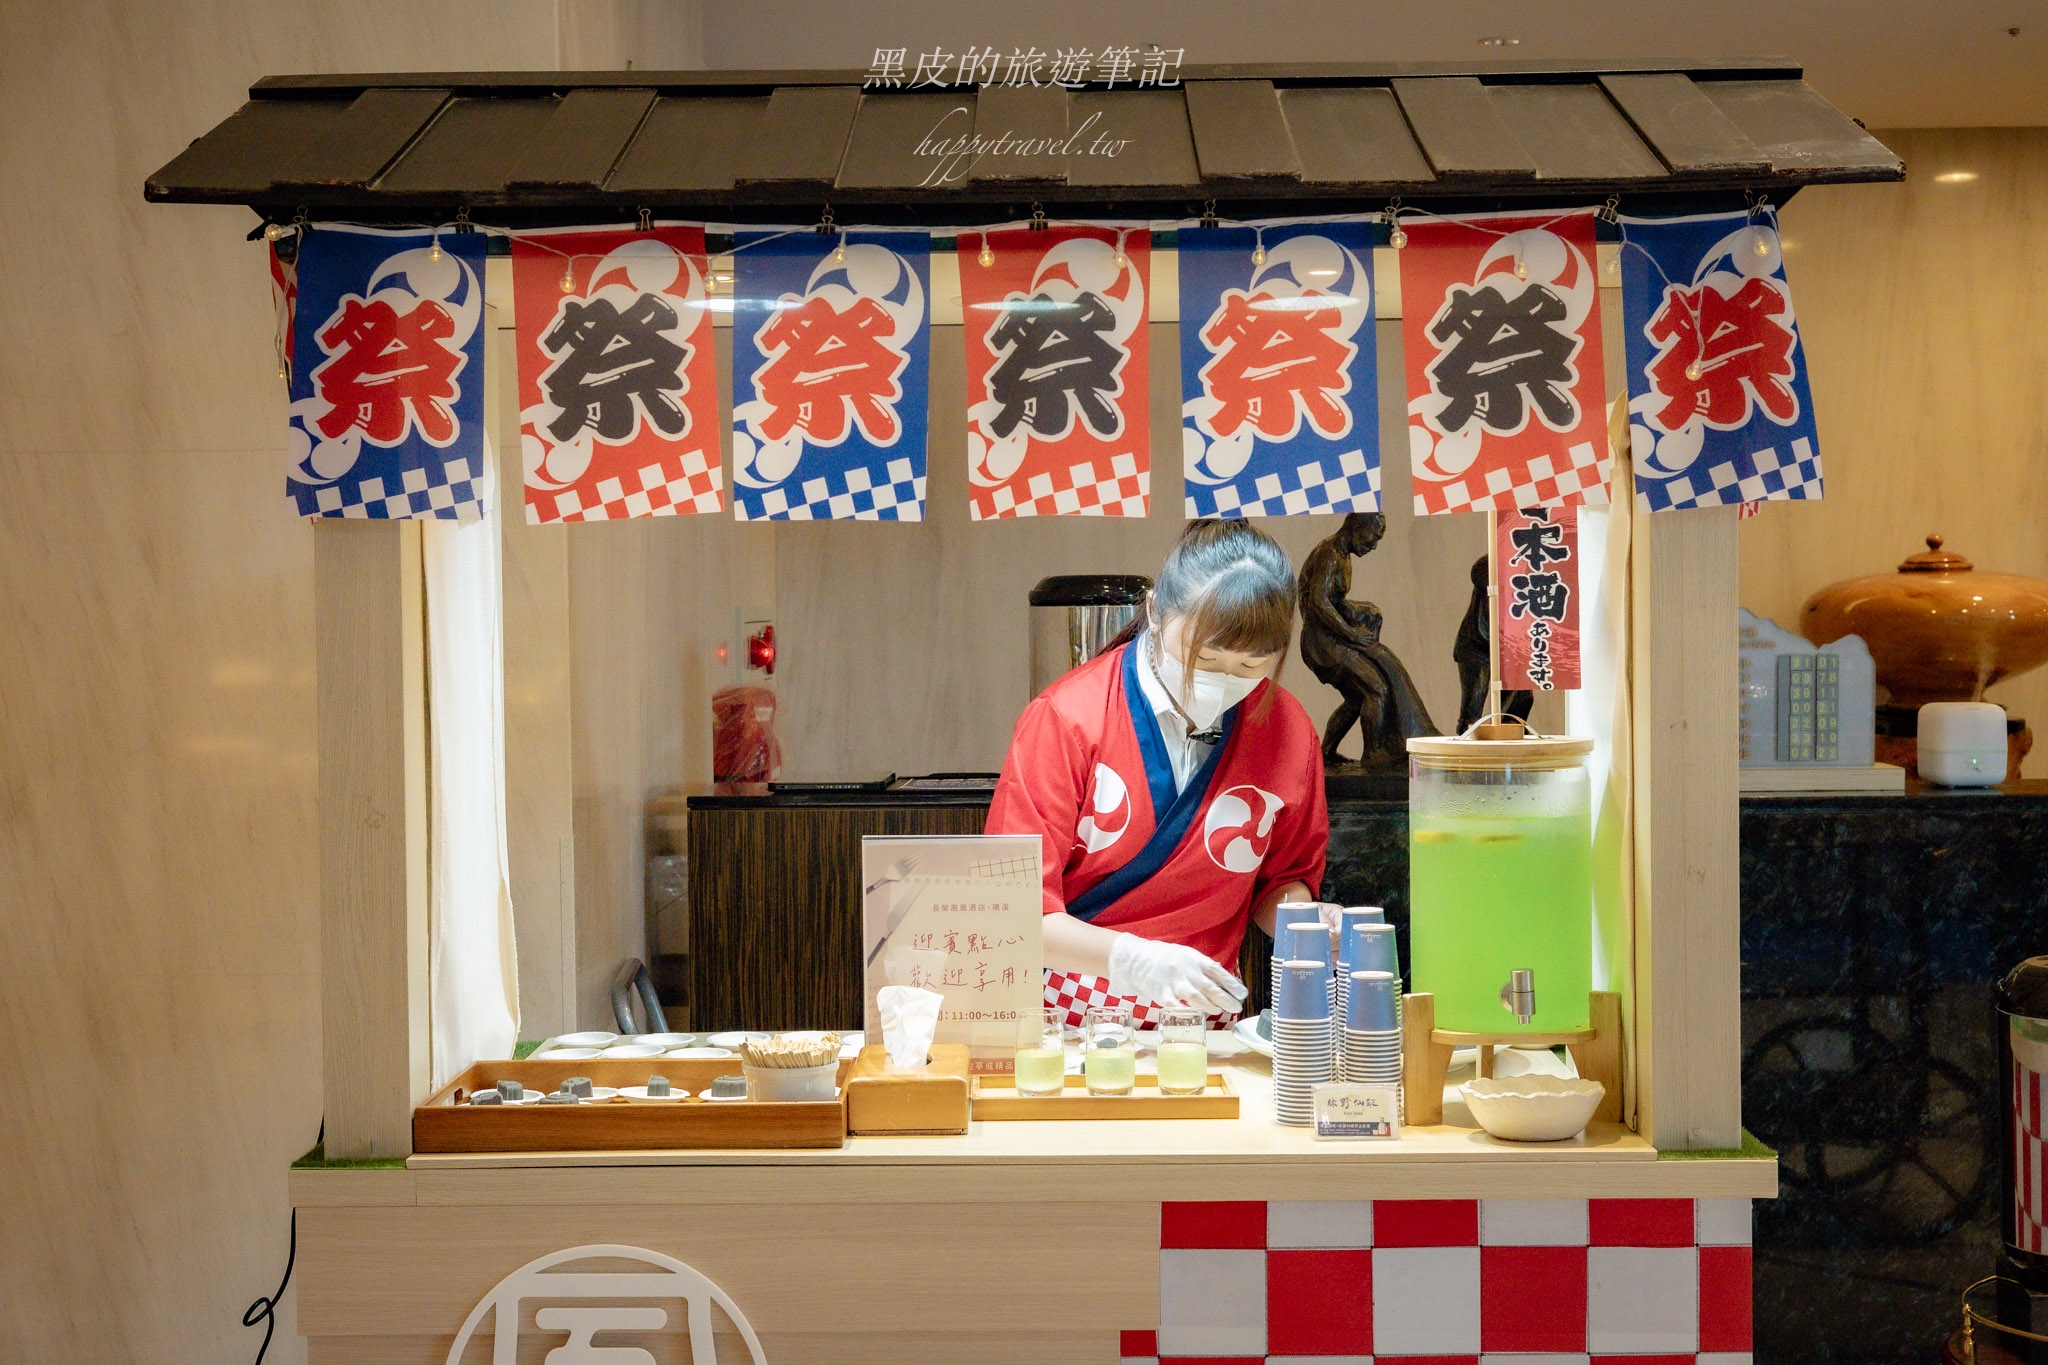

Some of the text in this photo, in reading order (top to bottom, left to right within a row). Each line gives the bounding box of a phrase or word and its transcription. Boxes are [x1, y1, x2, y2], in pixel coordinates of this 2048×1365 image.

[314, 297, 463, 442] 祭
[542, 292, 689, 443] 祭
[754, 296, 903, 442] 祭
[989, 291, 1125, 440] 祭
[1204, 289, 1354, 437] 祭
[1431, 282, 1579, 433] 祭
[1648, 277, 1794, 431] 祭
[912, 929, 1025, 955] 迎賓點心
